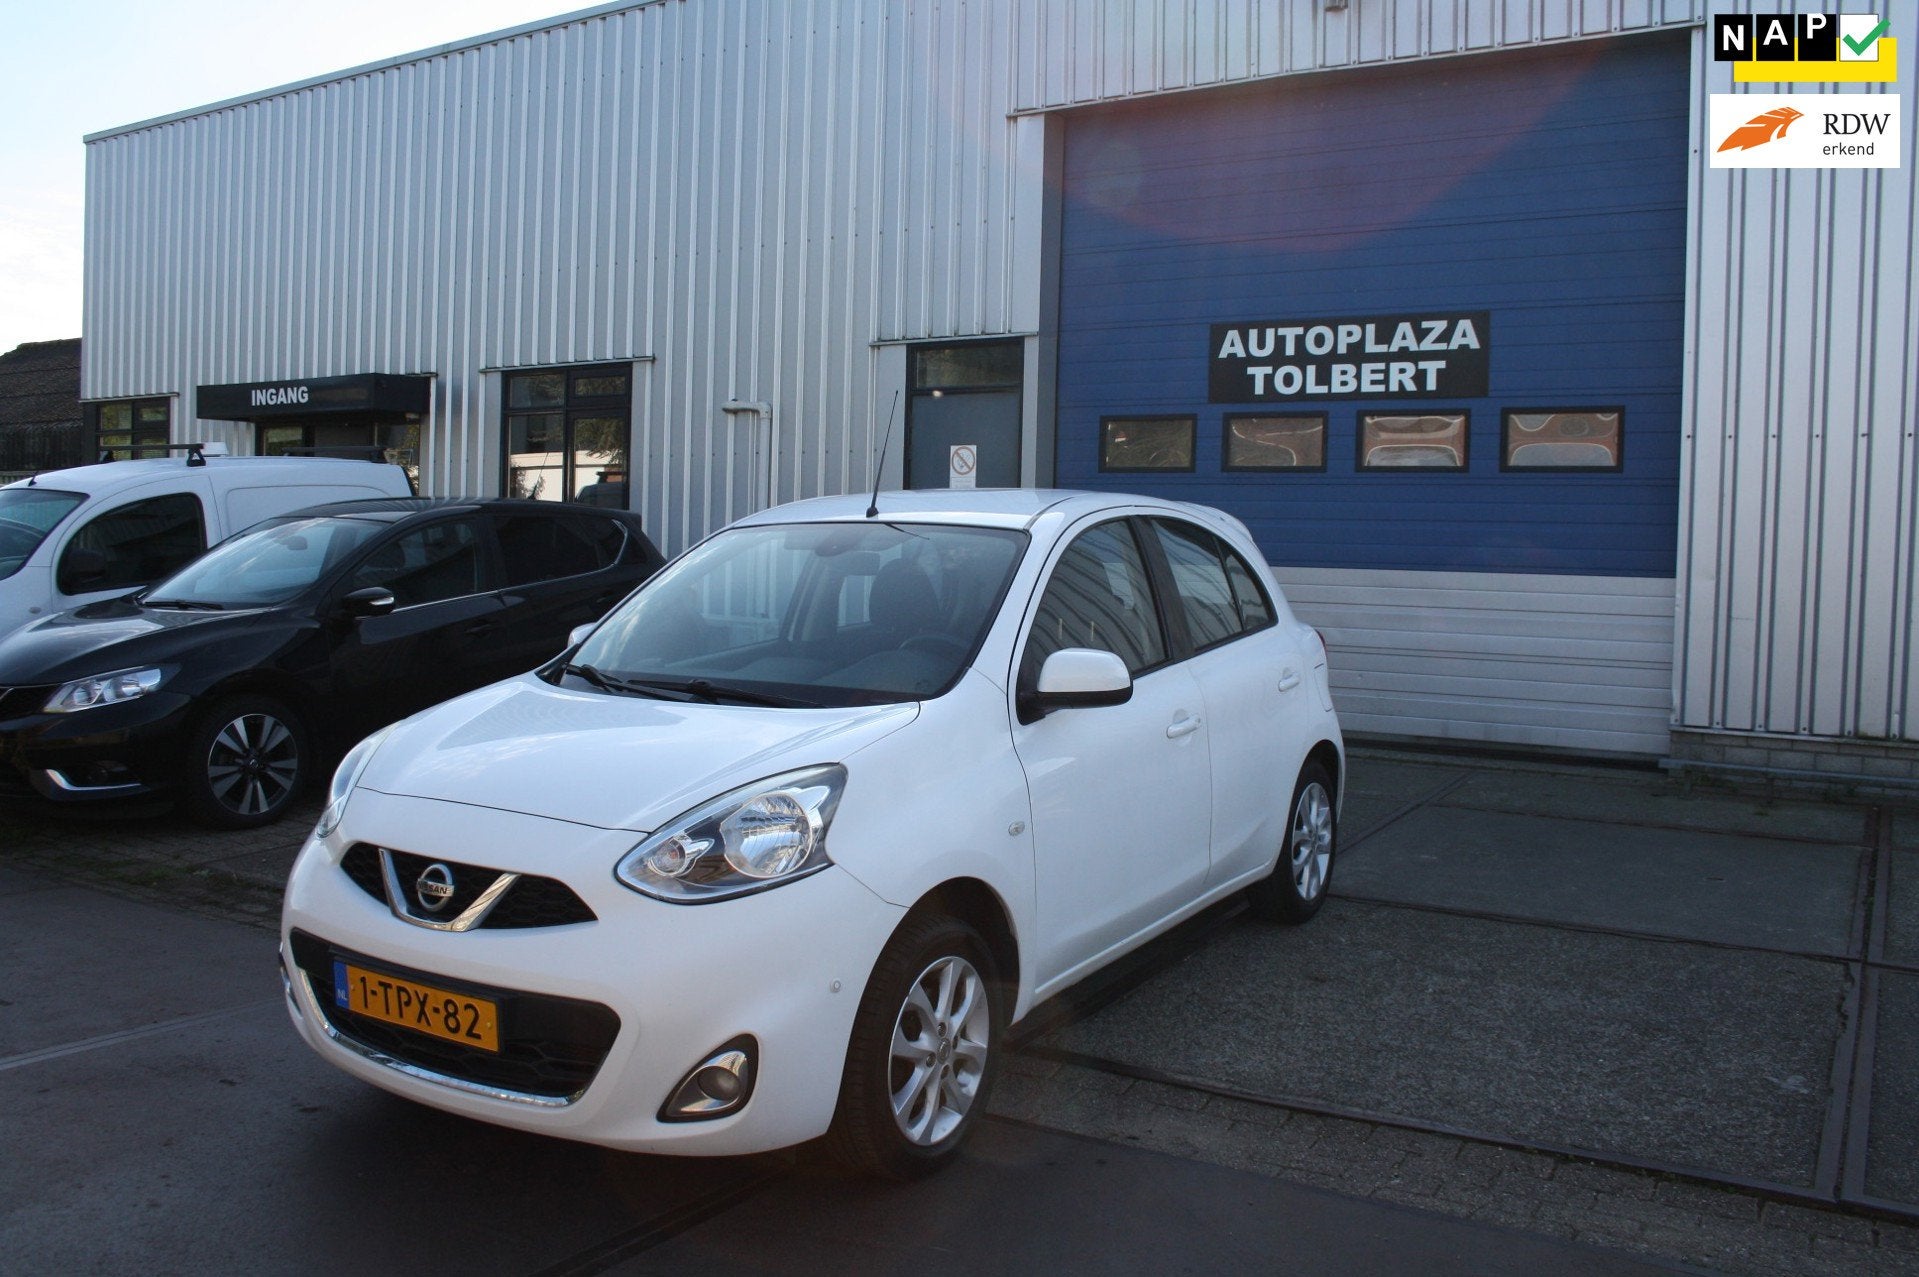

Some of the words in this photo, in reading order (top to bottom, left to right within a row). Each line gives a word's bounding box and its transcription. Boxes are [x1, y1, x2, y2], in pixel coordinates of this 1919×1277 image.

[1218, 319, 1481, 359] AUTOPLAZA
[1246, 360, 1447, 395] TOLBERT
[251, 386, 309, 407] INGANG
[337, 989, 348, 1001] NL
[360, 976, 482, 1040] 1-TPX-82
